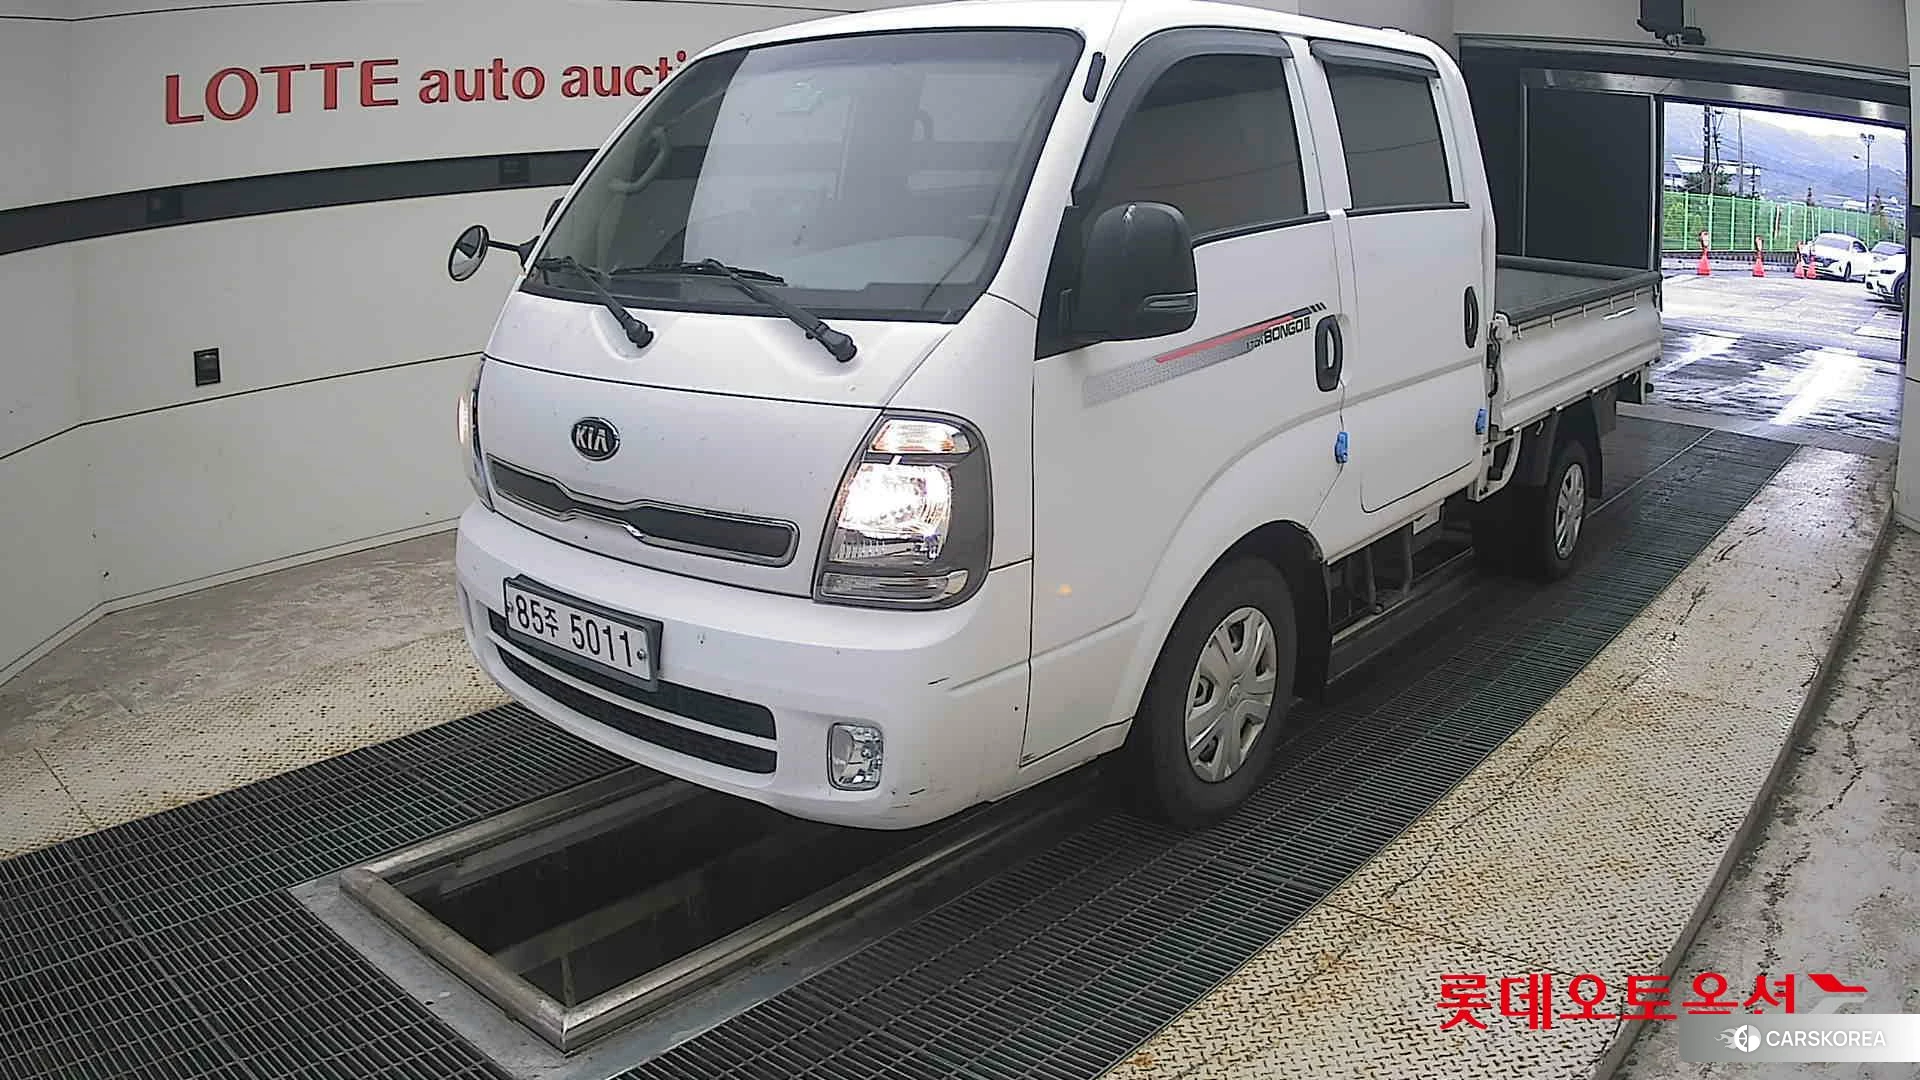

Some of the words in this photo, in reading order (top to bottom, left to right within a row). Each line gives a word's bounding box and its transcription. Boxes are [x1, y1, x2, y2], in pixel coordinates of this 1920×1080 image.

[165, 58, 399, 125] LOTTE
[418, 57, 546, 104] auto
[575, 424, 609, 453] KIA
[516, 594, 559, 638] 85주
[570, 613, 632, 667] 5011
